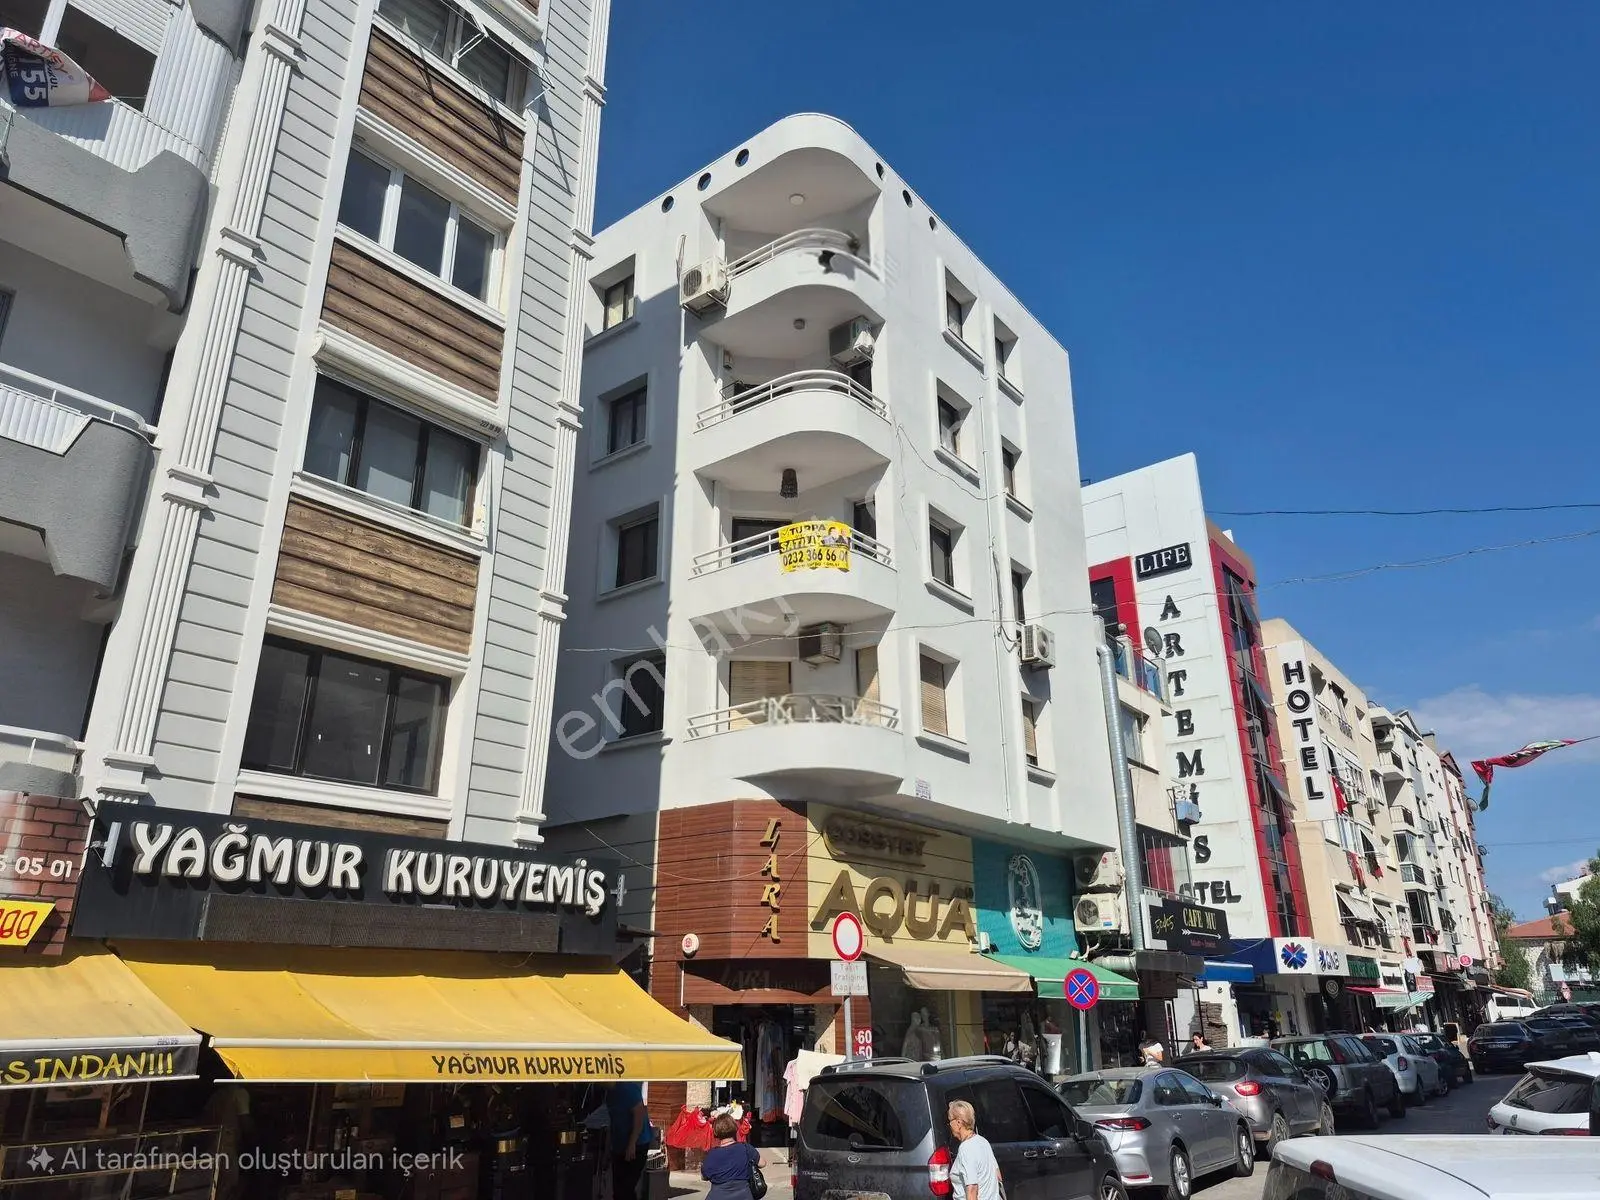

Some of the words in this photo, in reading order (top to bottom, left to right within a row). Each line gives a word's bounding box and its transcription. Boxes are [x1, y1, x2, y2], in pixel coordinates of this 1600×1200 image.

[782, 550, 804, 566] 0232
[806, 547, 823, 561] 366
[826, 547, 837, 562] 66
[1138, 545, 1189, 575] LIFE
[1282, 659, 1324, 801] HOTEL
[15, 856, 44, 875] 05
[50, 859, 73, 878] 01
[131, 821, 363, 890] YAĞMUR
[384, 847, 607, 917] KURUYEMİŞ
[760, 816, 782, 944] LARA
[810, 869, 978, 944] AQUA
[1182, 907, 1204, 929] CAFE
[0, 1052, 173, 1084] SINDAN!!!
[432, 1053, 520, 1075] YAĞMUR
[525, 1053, 625, 1078] KURUYEMİŞ
